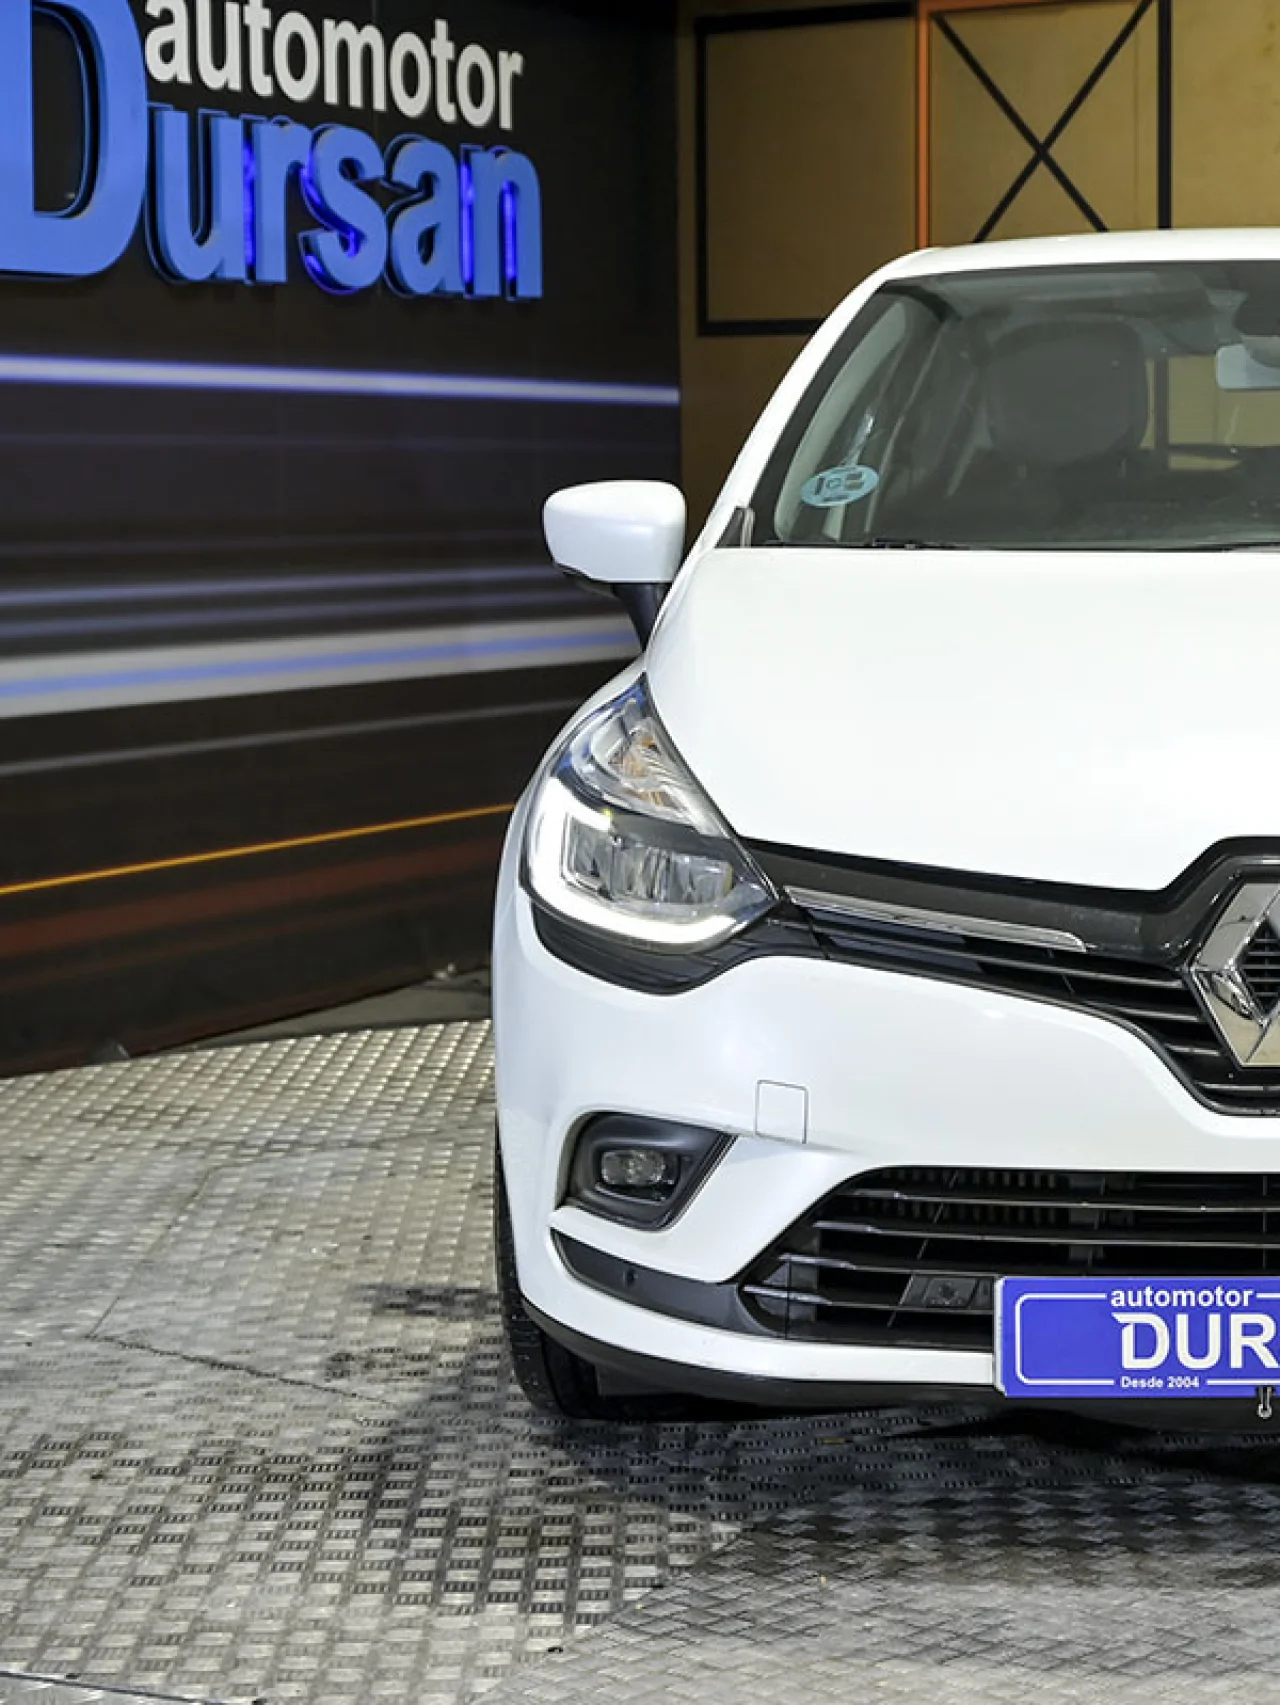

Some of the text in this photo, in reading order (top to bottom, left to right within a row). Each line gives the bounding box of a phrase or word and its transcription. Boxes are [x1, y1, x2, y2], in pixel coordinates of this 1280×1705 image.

[145, 0, 524, 129] automotor
[0, 0, 543, 299] Dursan
[1110, 1285, 1254, 1308] automotor
[1120, 1375, 1200, 1389] Desde 2004
